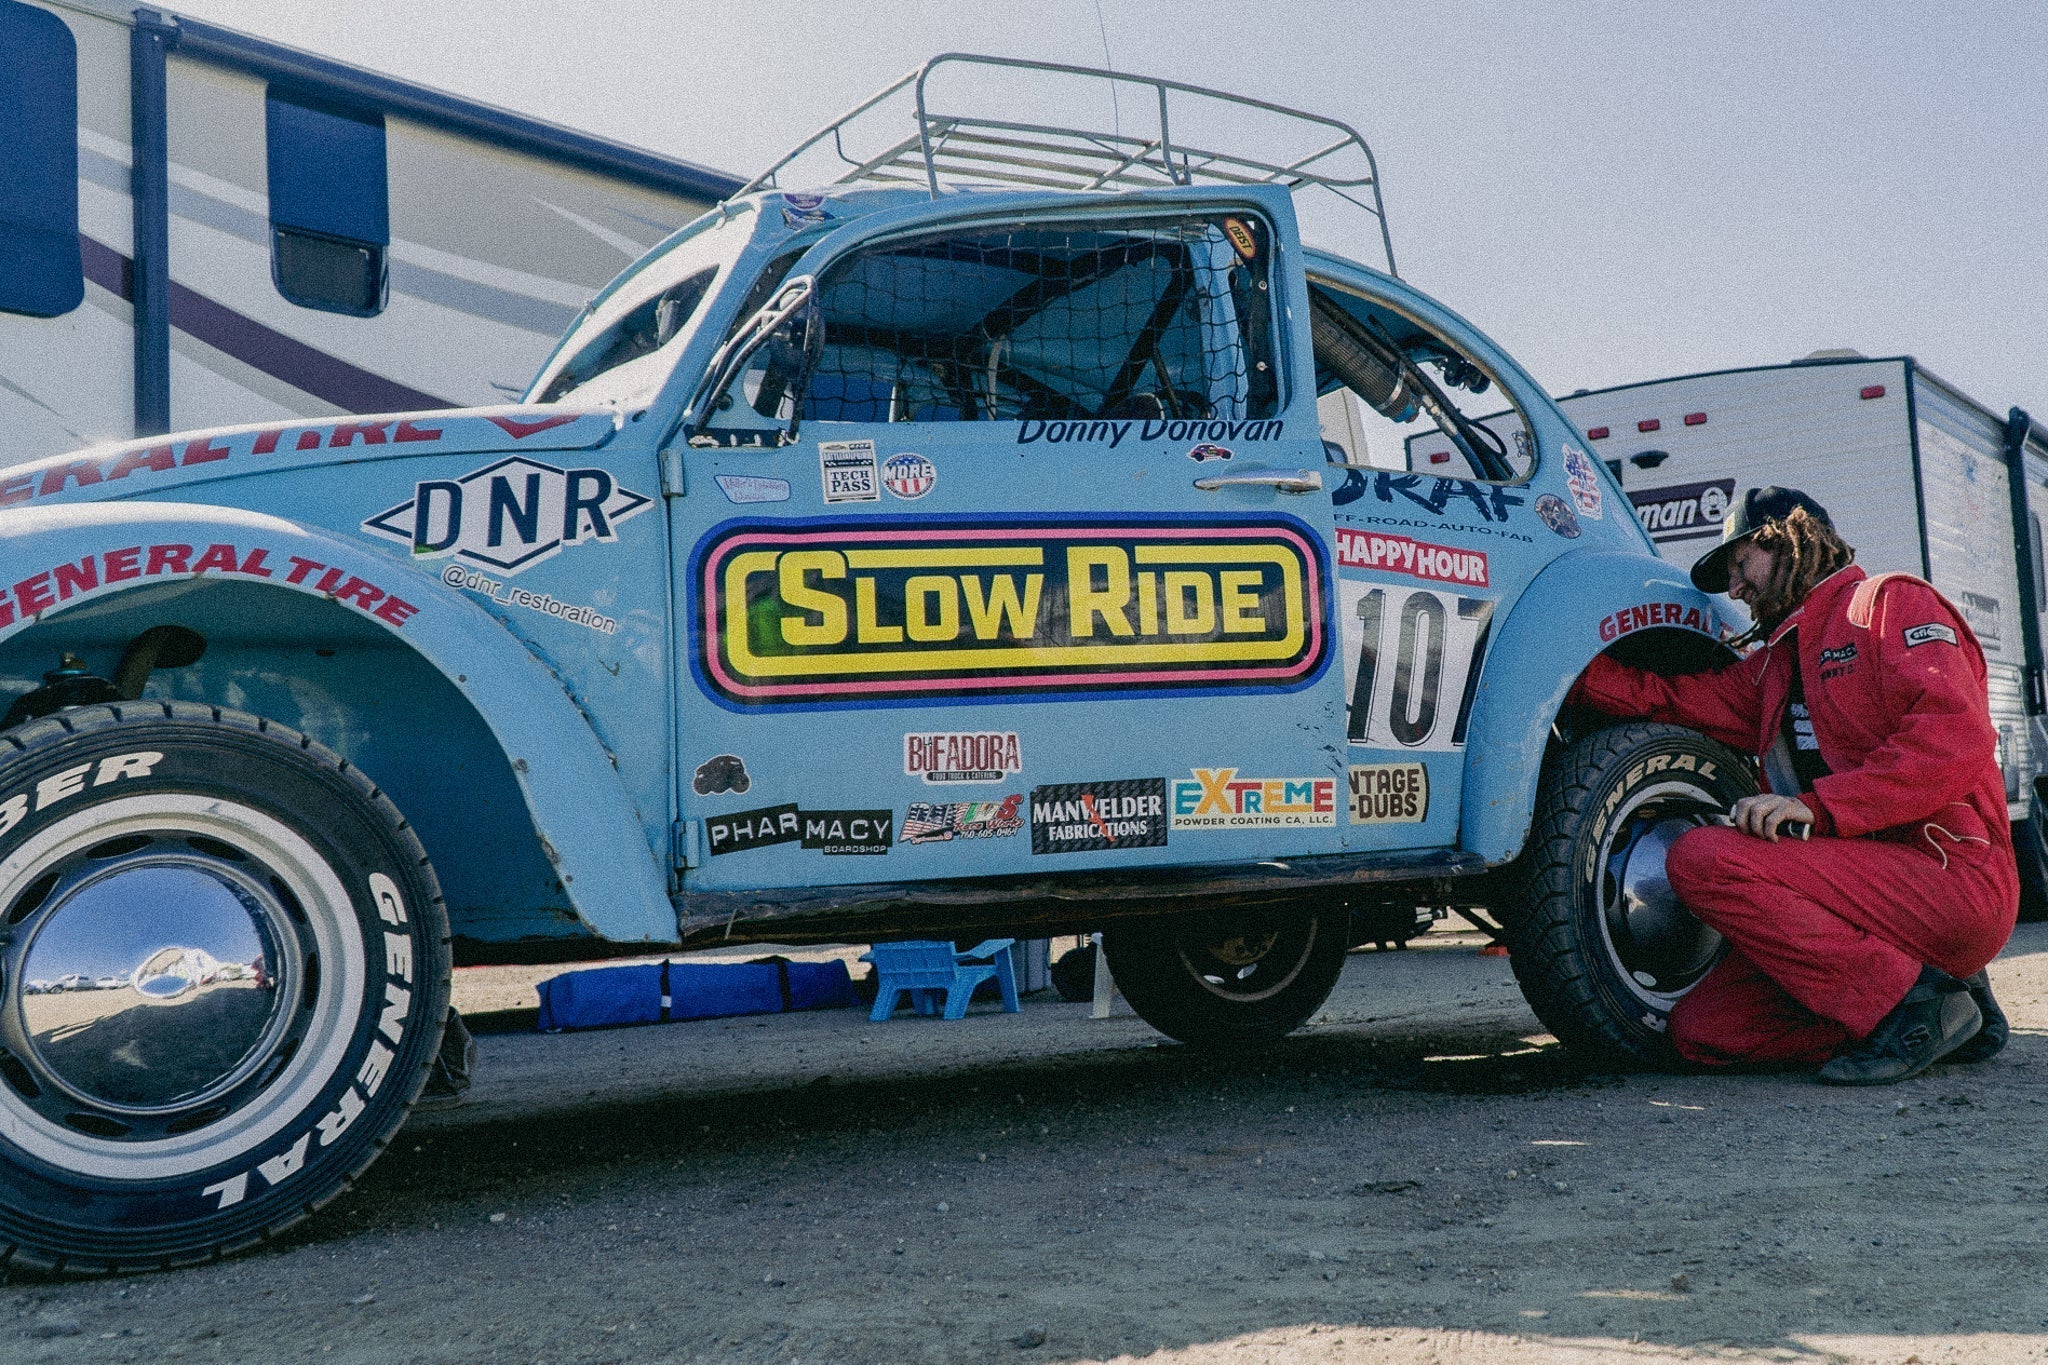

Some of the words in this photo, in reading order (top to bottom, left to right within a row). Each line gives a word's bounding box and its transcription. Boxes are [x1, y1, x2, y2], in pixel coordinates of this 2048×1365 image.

[1017, 420, 1133, 448] Donny
[1140, 420, 1283, 442] Donovan
[830, 470, 869, 481] TECH
[832, 479, 871, 493] PASS
[414, 469, 612, 554] DNR
[1335, 531, 1416, 569] HAPPY
[1417, 548, 1486, 583] HOUR
[285, 556, 420, 628] TIRE
[443, 564, 616, 634] @dnr_restoration
[1600, 603, 1714, 642] GENERAL
[1347, 589, 1494, 747] 107
[909, 735, 1020, 772] BUFADORA
[1033, 796, 1162, 824] MANWELDER
[1175, 770, 1334, 814] EXTREME
[1049, 820, 1148, 841] FABRICATIONS
[1175, 817, 1225, 826] POWDER
[1230, 816, 1281, 825] COATING
[1585, 754, 1717, 884] GENERAL
[825, 845, 887, 853] BOARDSHOP
[202, 872, 413, 1210] GENERAL
